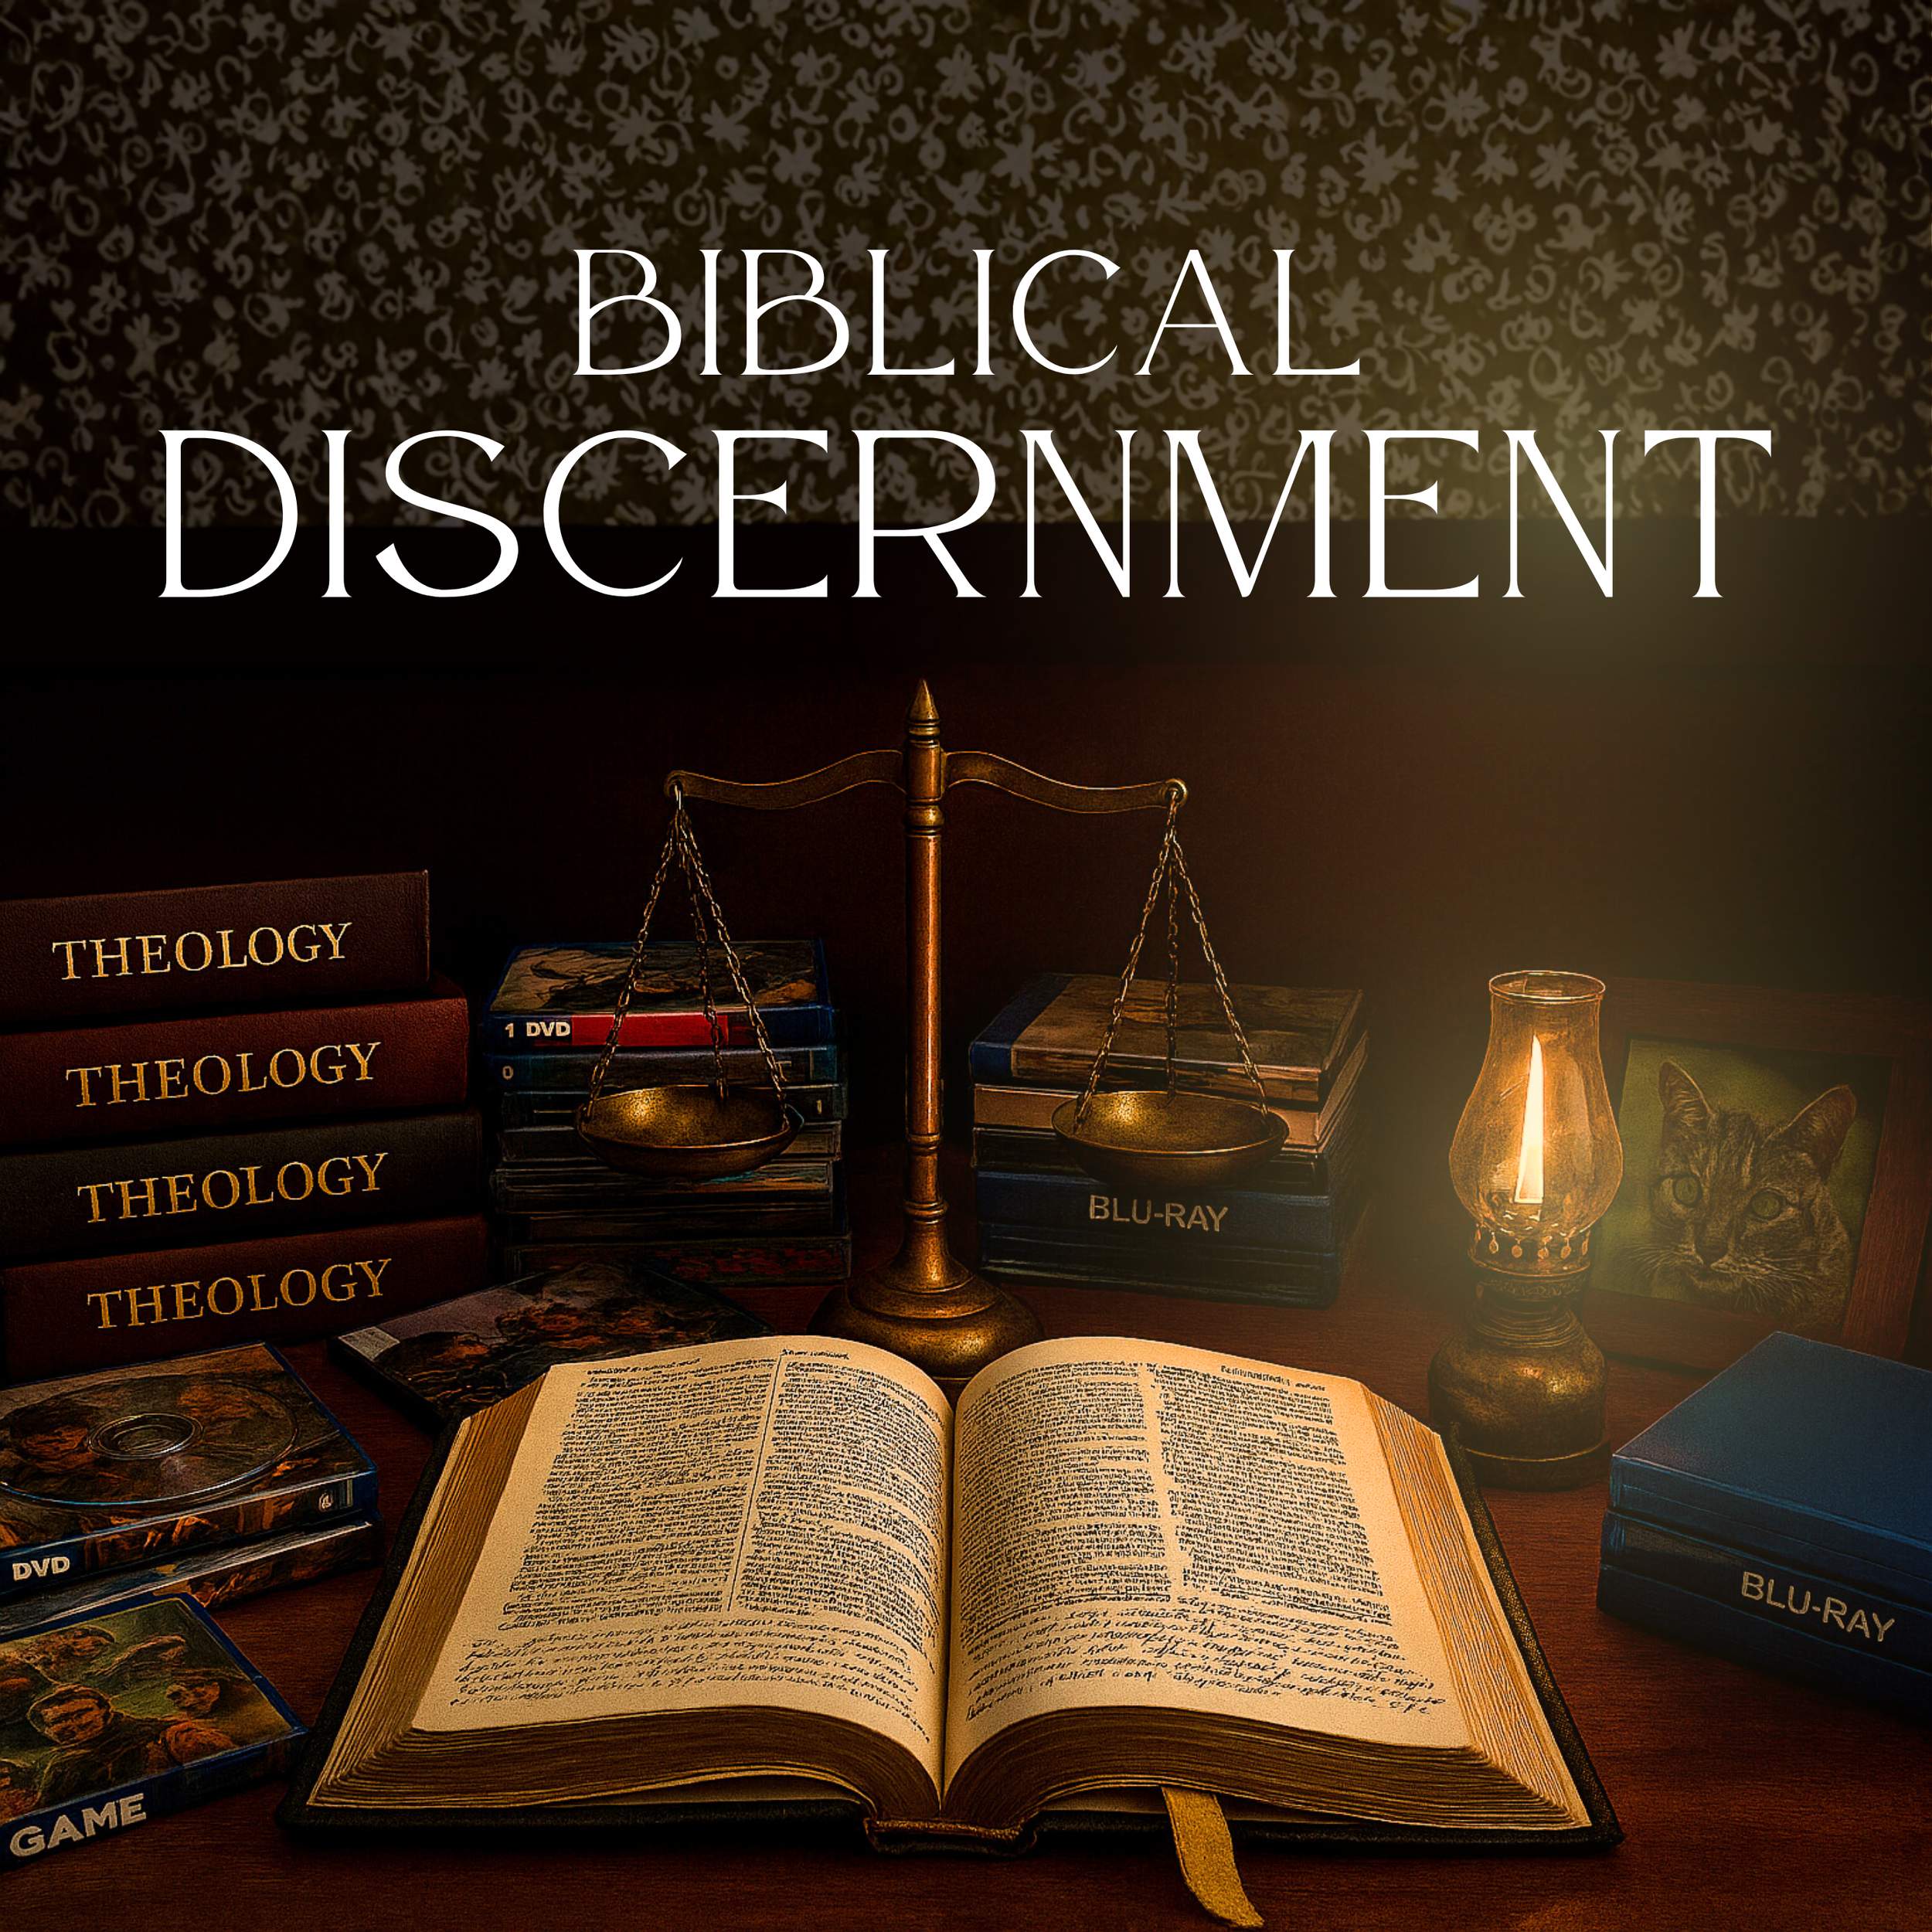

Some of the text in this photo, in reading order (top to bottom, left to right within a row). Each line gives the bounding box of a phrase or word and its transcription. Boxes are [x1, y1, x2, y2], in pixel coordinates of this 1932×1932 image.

[52, 922, 352, 980] THEOLOGY
[505, 1021, 571, 1038] 1 DVD
[66, 1042, 381, 1107] THEOLOGY
[77, 1152, 388, 1223] THEOLOGY
[1089, 1194, 1229, 1232] BLU-RAY
[87, 1258, 392, 1328] THEOLOGY
[12, 1556, 70, 1581] DVD
[1741, 1571, 1895, 1642] BLU-RAY
[9, 1792, 147, 1857] GAME
